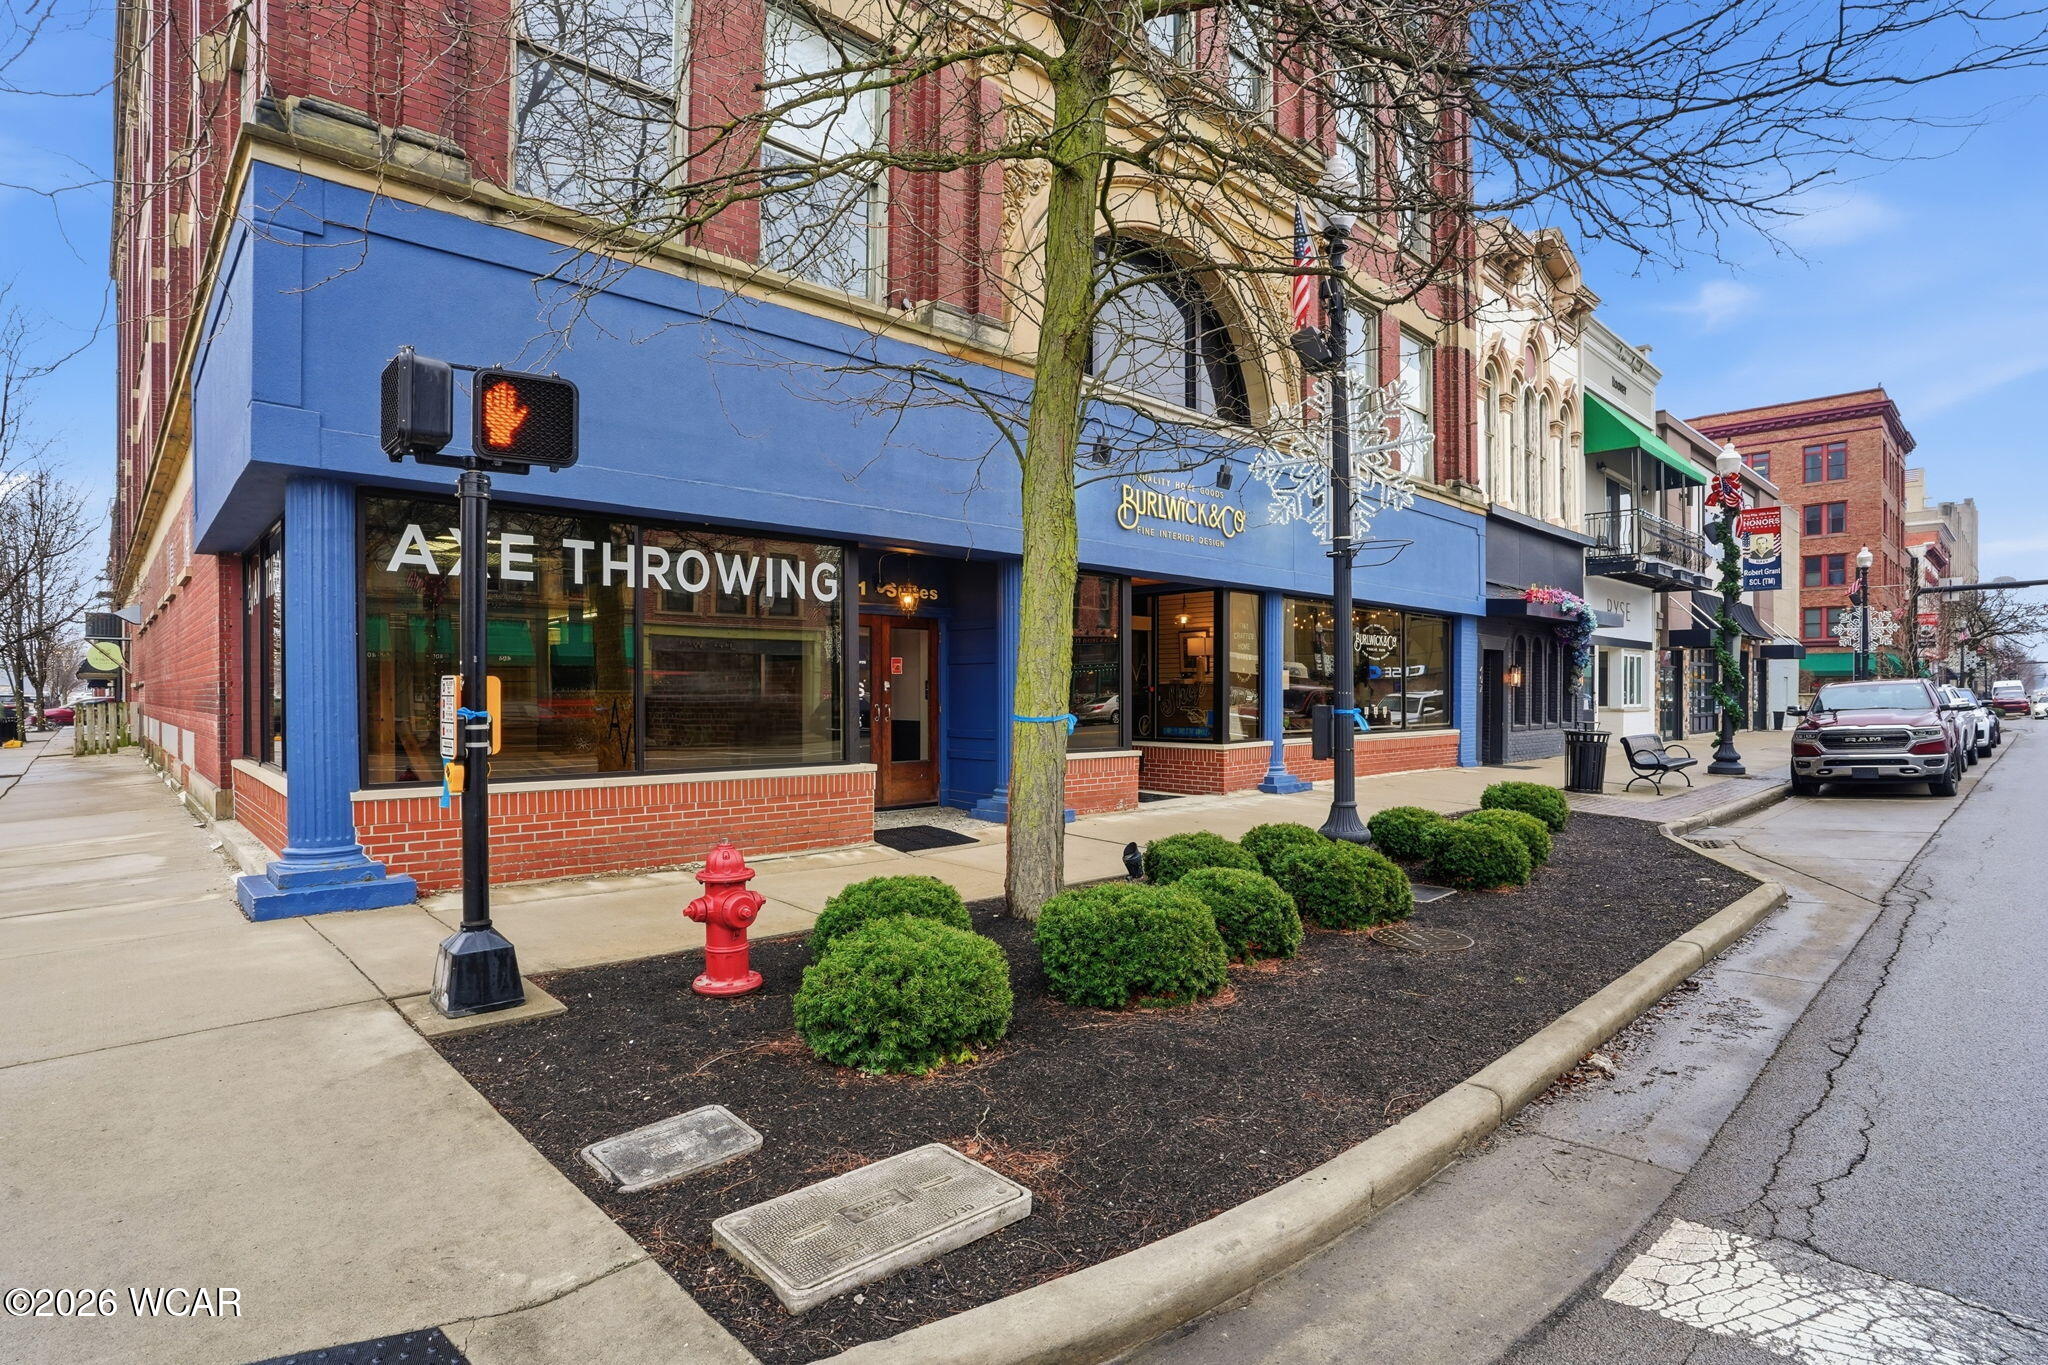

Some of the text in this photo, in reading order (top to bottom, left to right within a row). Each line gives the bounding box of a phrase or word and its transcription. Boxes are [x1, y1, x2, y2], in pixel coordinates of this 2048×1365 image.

[1200, 486, 1224, 500] GOODS
[1743, 517, 1780, 527] HONORS
[1137, 526, 1225, 548] FINE INTERIOR DESIGN
[562, 538, 838, 602] THROWING
[1765, 567, 1781, 575] Grant
[1748, 578, 1761, 586] SCL
[877, 582, 938, 600] Ses
